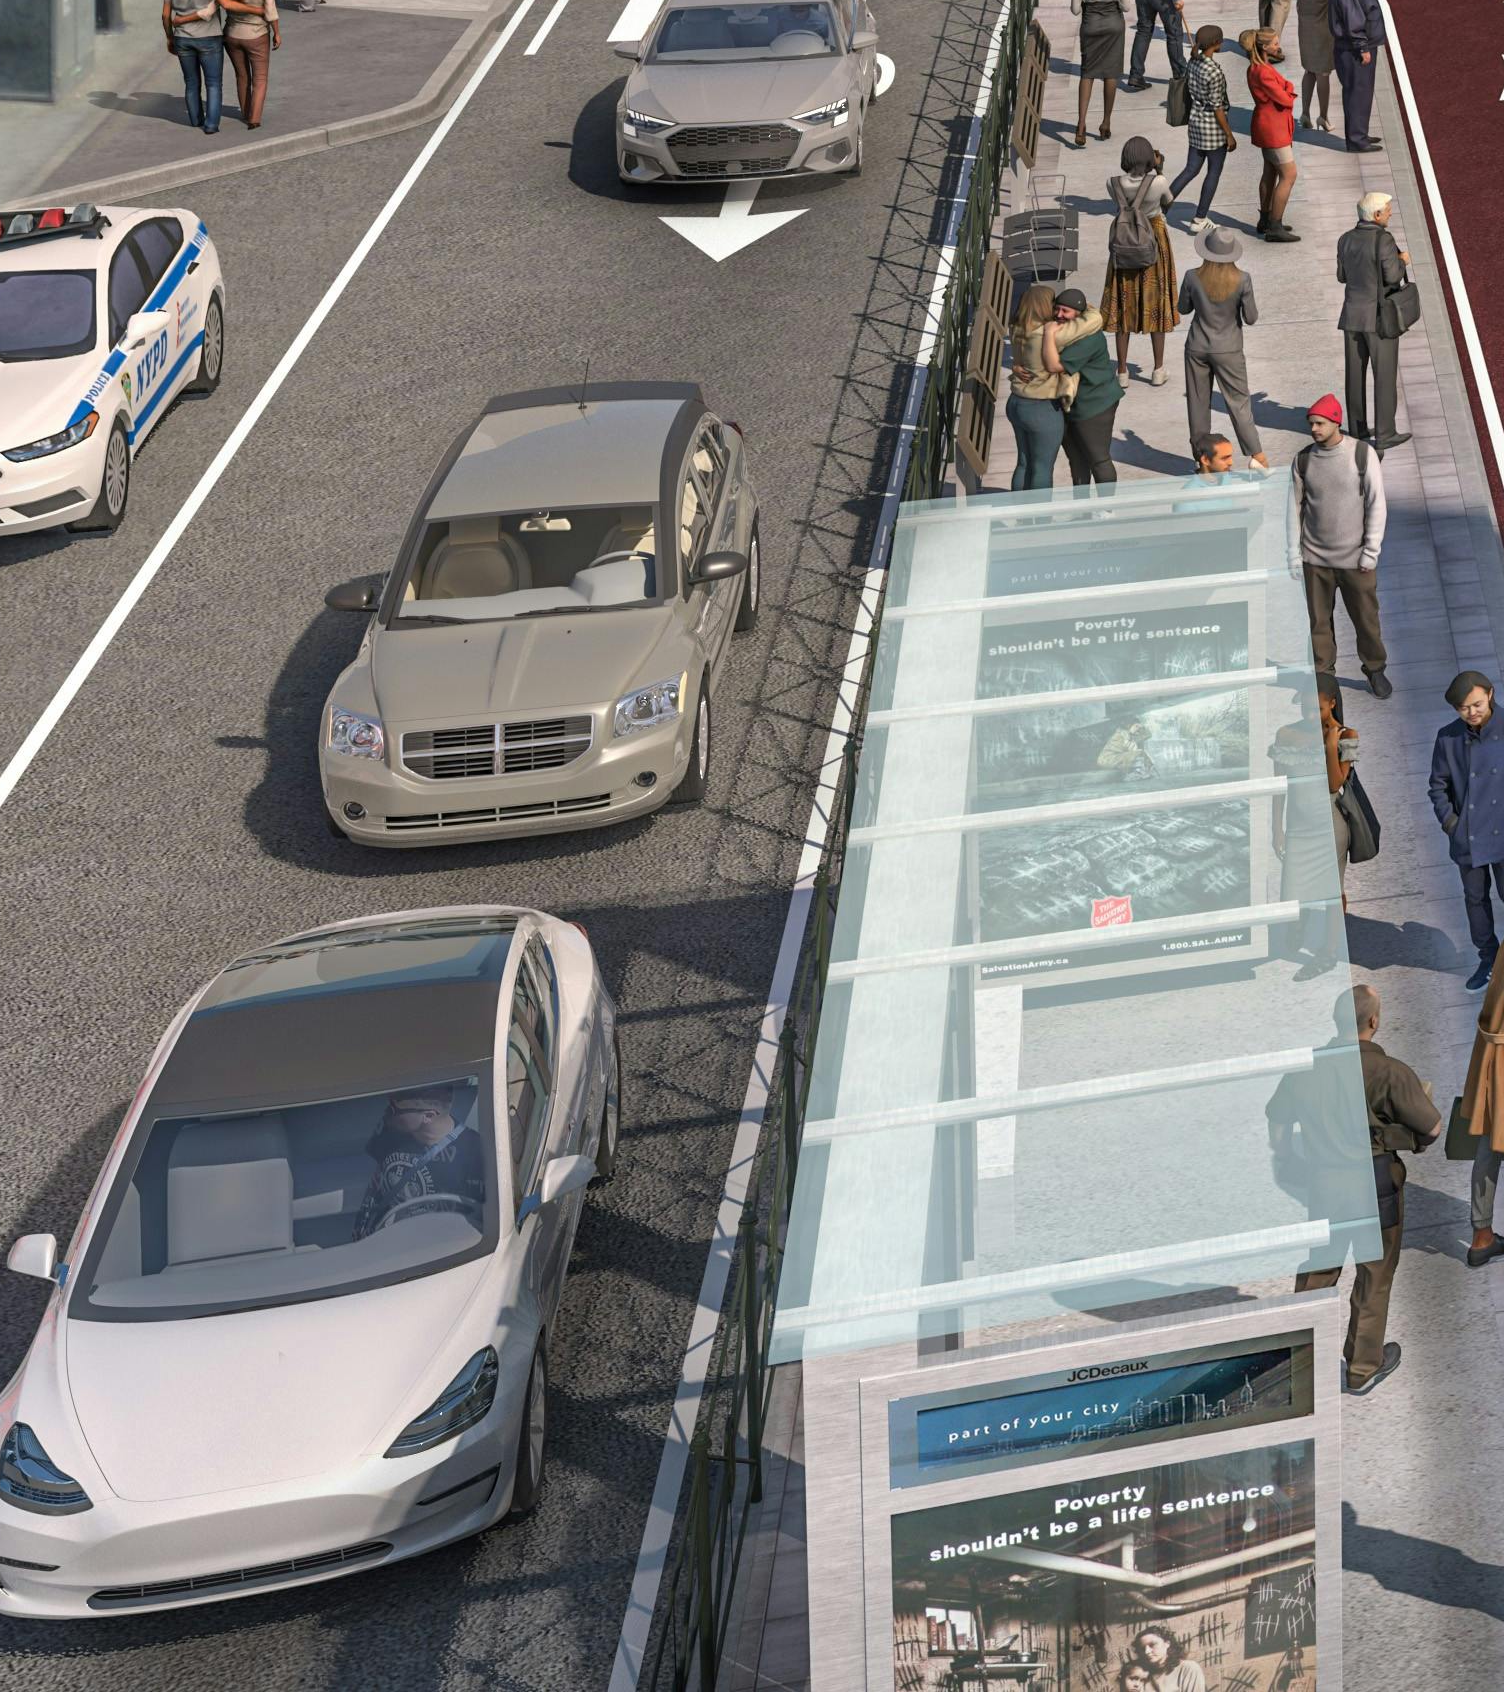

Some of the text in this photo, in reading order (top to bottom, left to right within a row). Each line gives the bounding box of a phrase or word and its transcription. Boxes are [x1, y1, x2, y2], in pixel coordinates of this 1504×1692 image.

[136, 329, 167, 403] NYPD
[84, 372, 110, 403] POLICE
[1011, 565, 1122, 584] part of your city
[1072, 636, 1090, 647] be
[1114, 630, 1140, 642] life
[1146, 624, 1220, 639] sentence
[1075, 618, 1136, 631] Poverty
[1095, 903, 1128, 926] SALVATION
[1100, 901, 1114, 912] THE
[1161, 935, 1243, 951] 1.800.SAL.ARMY
[982, 957, 1069, 974] SalvationArmy.ca
[1067, 1360, 1148, 1383] JCDecaux
[948, 1401, 1120, 1443] part of your city
[1049, 1520, 1078, 1537] be
[1089, 1515, 1102, 1528] a
[1112, 1504, 1152, 1526] life
[1162, 1484, 1274, 1515] sentence
[1054, 1484, 1147, 1514] Poverty
